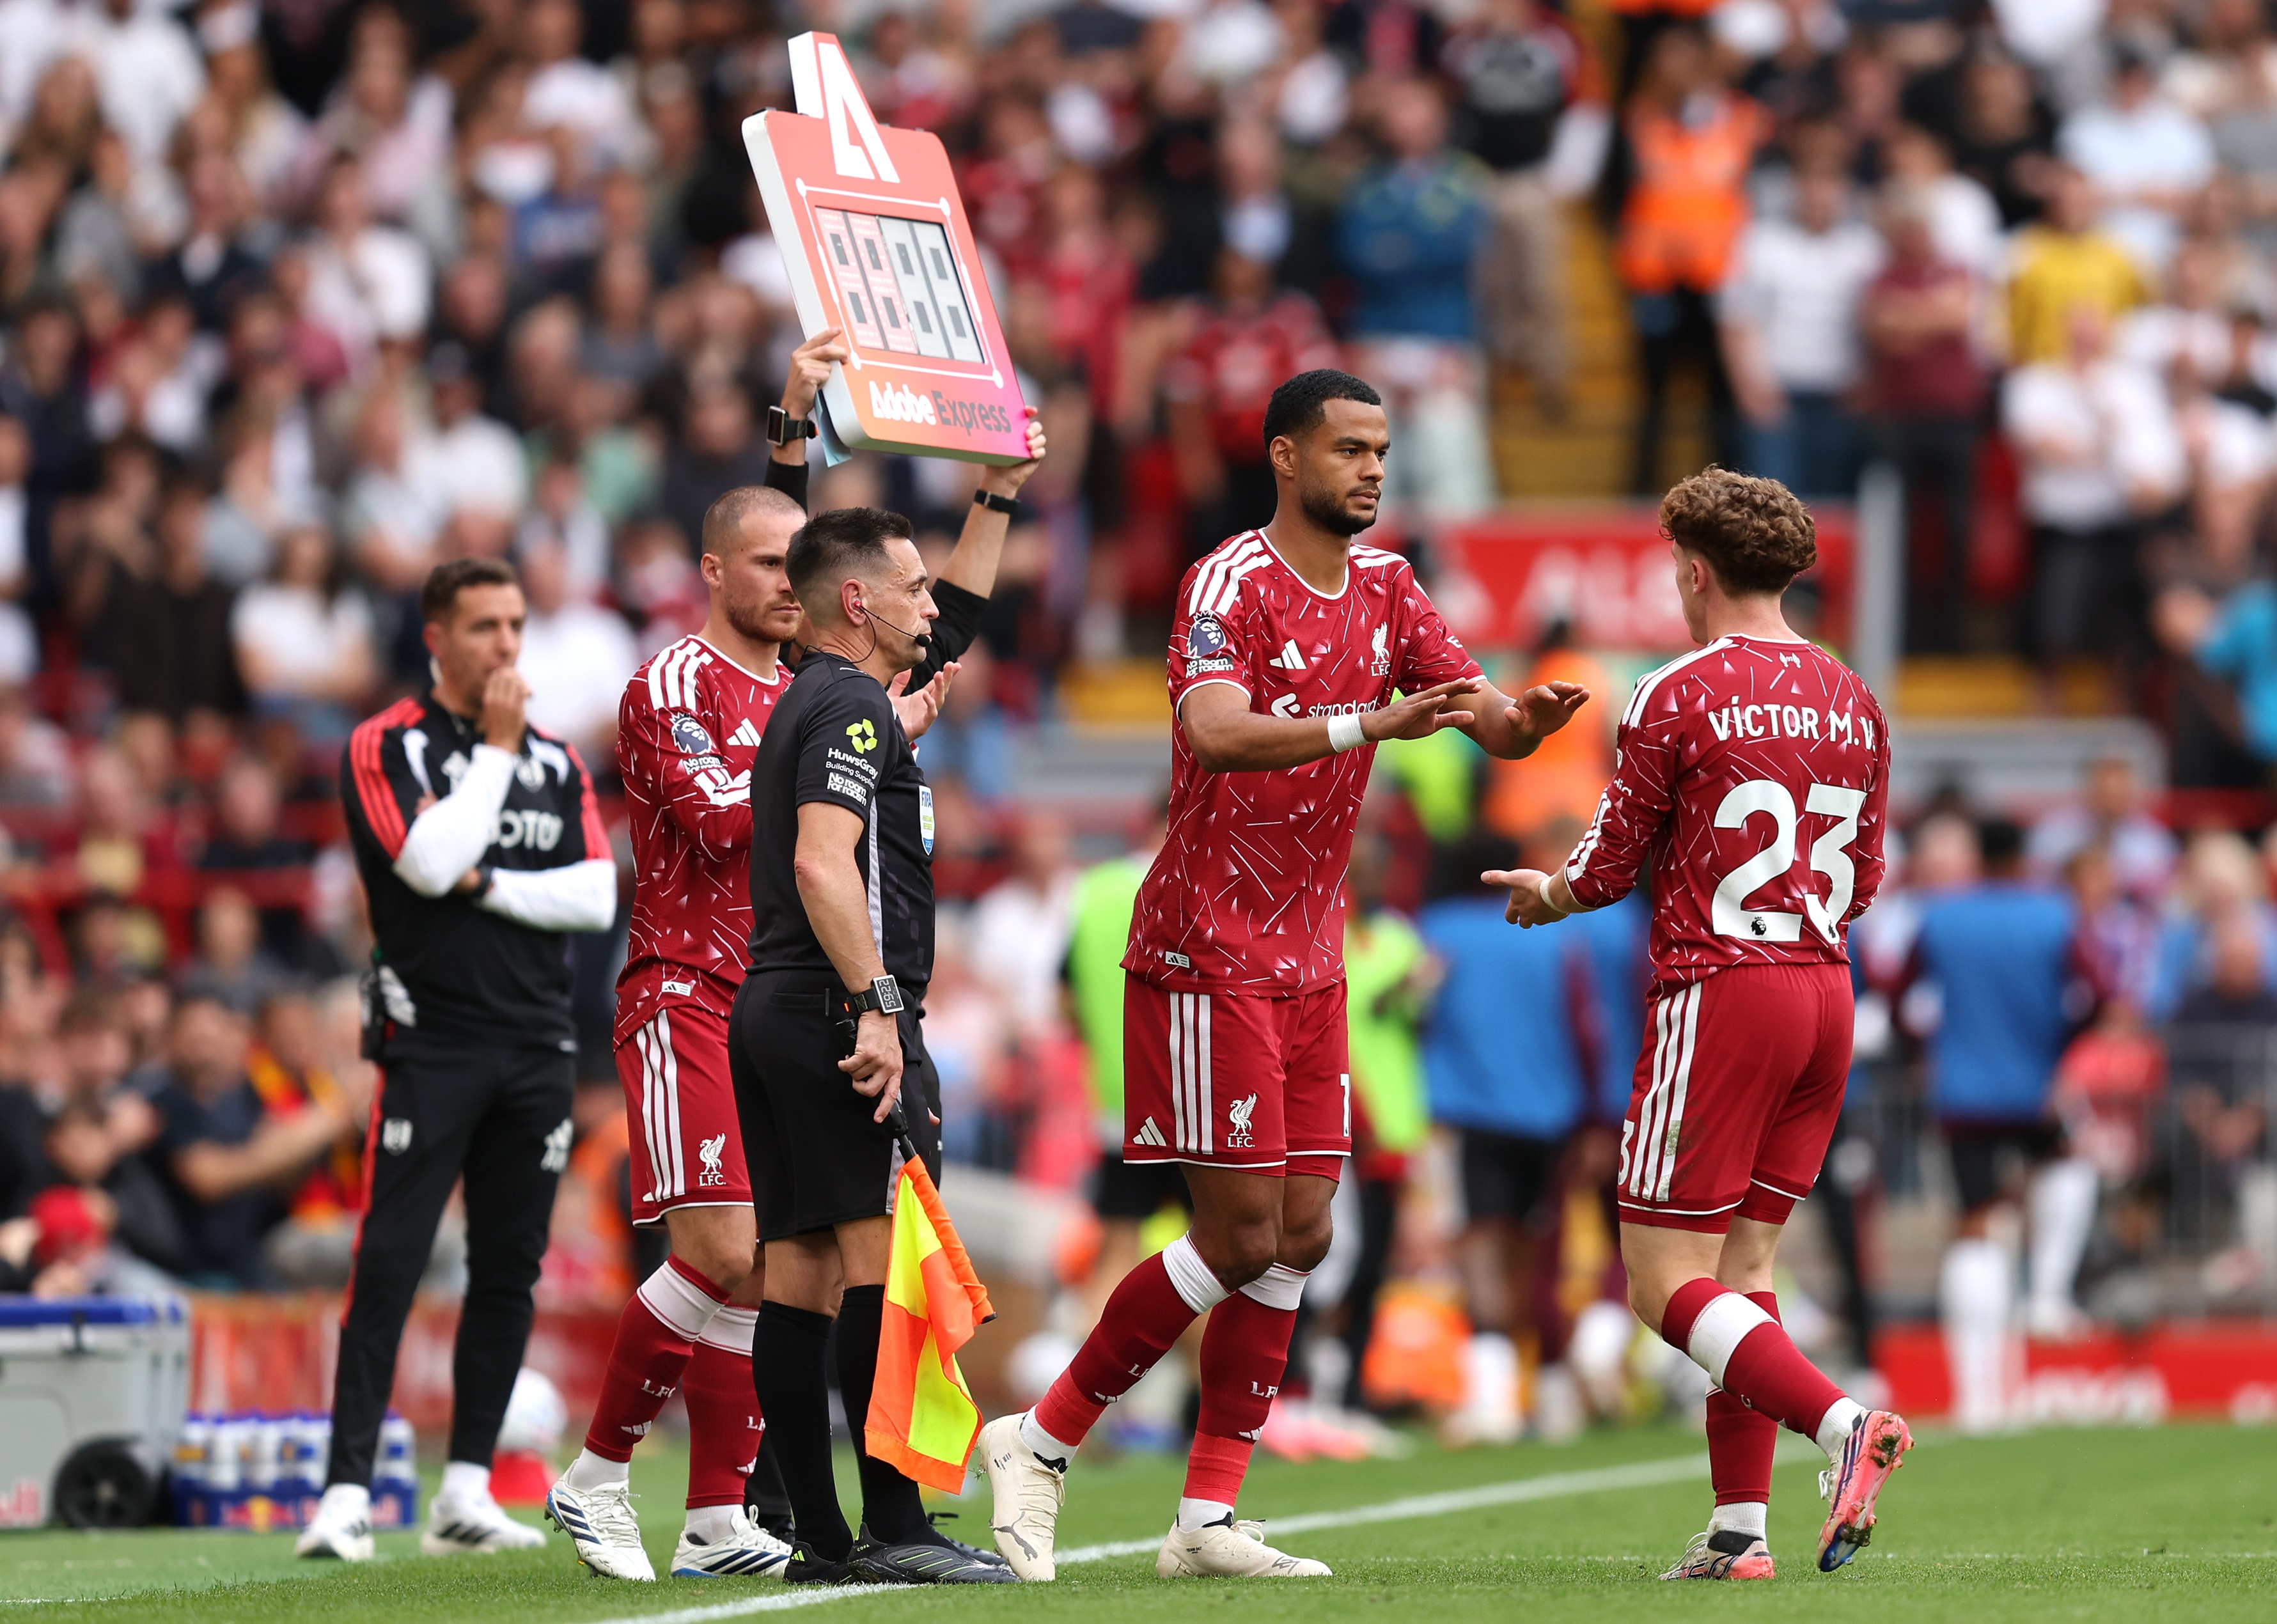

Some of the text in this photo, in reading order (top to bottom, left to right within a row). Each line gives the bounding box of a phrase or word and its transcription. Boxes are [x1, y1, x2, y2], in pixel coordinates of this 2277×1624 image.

[869, 380, 1012, 436] Adobe Express
[1199, 664, 1234, 673] racism
[1708, 696, 1820, 742] VÍCTOR
[683, 758, 699, 770] No
[698, 756, 721, 765] room
[826, 761, 854, 776] Building
[827, 747, 879, 779] HuwsGray
[827, 781, 868, 806] for racism
[828, 772, 867, 797] No room
[921, 791, 932, 808] FIFA
[1712, 779, 1868, 945] 23
[879, 980, 896, 1008] 59:22
[1228, 1136, 1256, 1148] L.F.C.
[699, 1174, 726, 1187] L.F.C.
[857, 1543, 870, 1552] COPA
